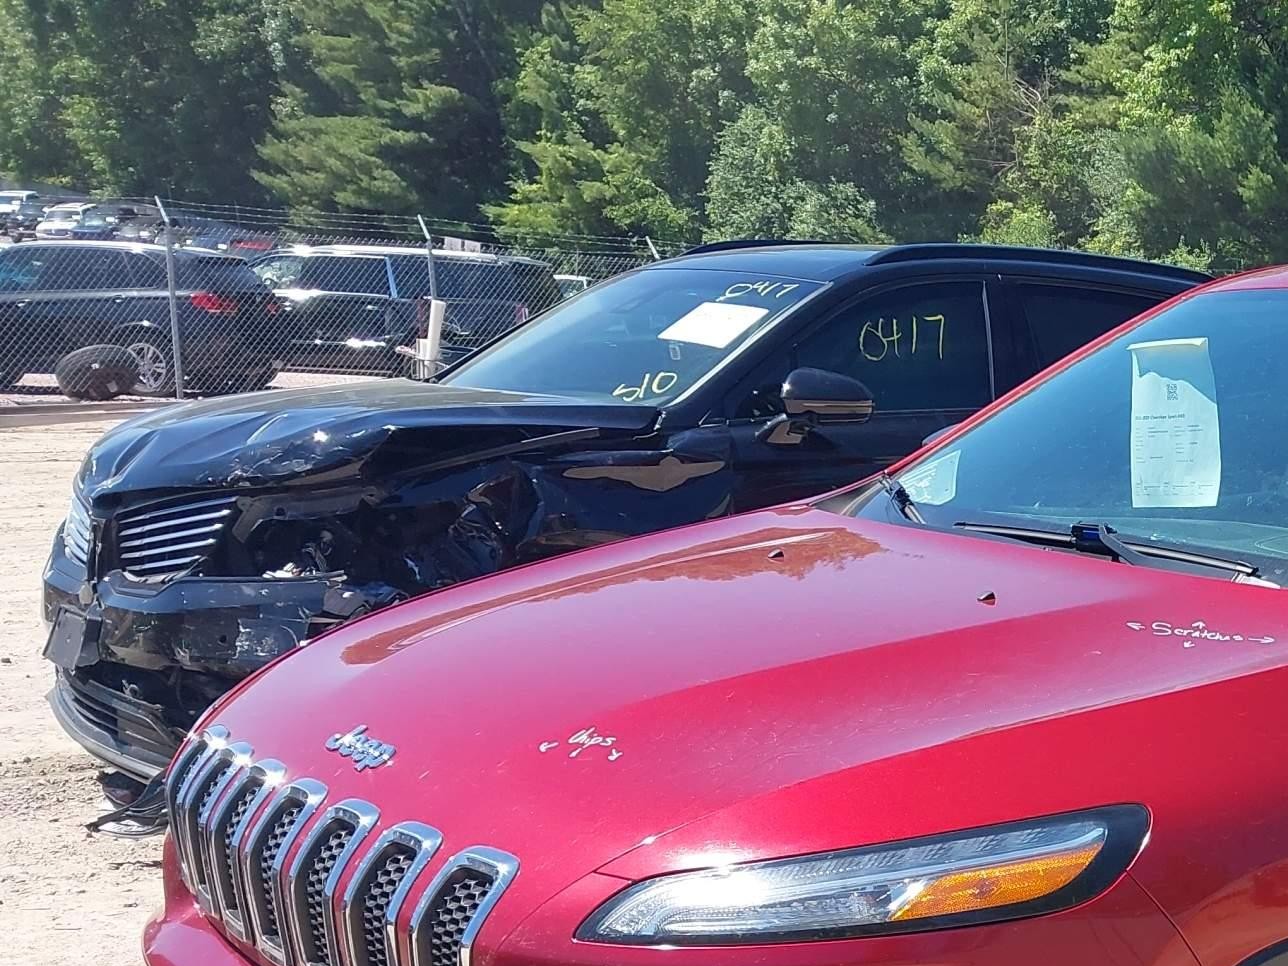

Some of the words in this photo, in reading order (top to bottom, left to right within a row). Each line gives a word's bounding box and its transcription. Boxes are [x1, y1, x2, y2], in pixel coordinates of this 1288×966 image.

[716, 280, 800, 302] 0417
[858, 314, 946, 361] 0417
[325, 724, 397, 773] Jeep
